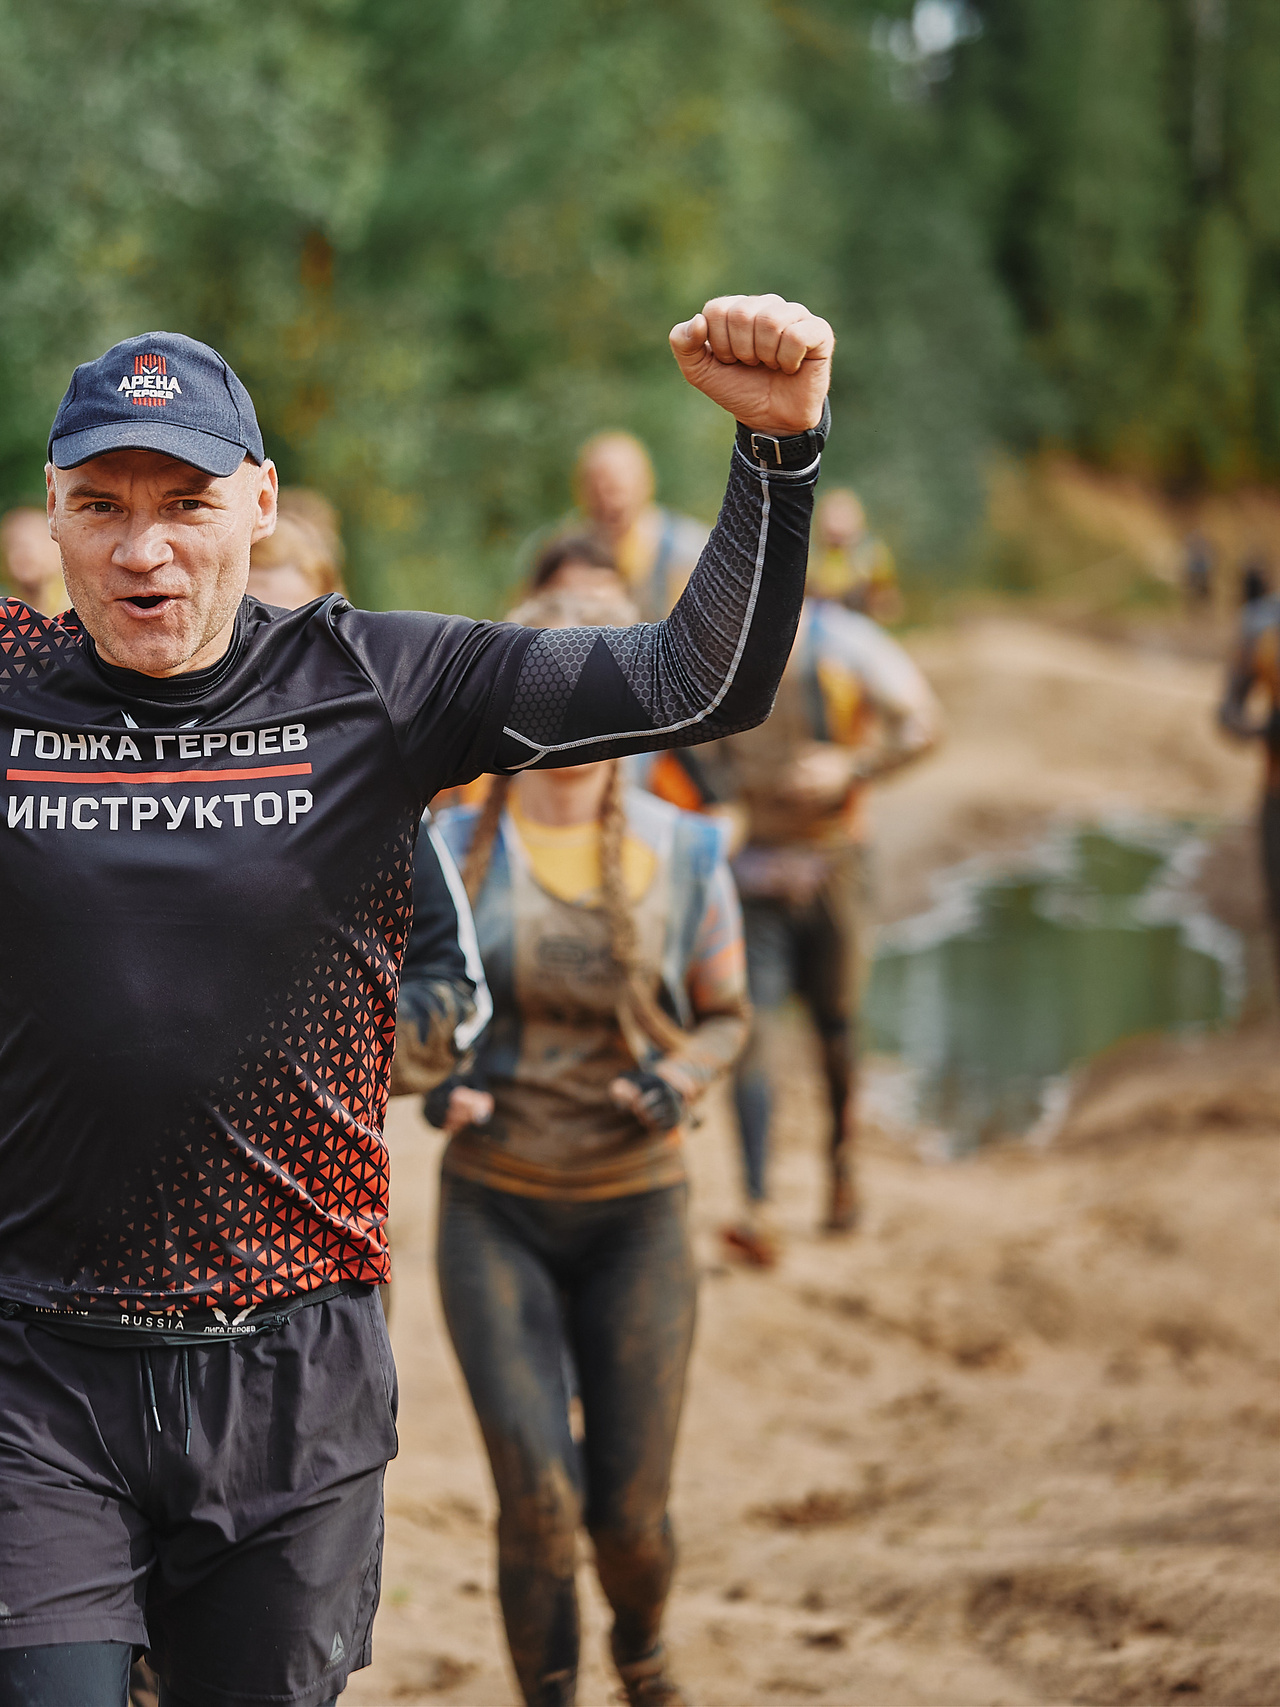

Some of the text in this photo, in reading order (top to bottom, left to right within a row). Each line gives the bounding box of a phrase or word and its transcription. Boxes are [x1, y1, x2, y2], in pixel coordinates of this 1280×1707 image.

[117, 375, 182, 395] АРЕНА
[125, 389, 174, 399] ГЕРОЕВ
[10, 723, 308, 761] ГОНКА ГЕРОЕВ
[7, 789, 313, 831] ИНСТРУКТОР
[121, 1314, 184, 1331] RUSSIA
